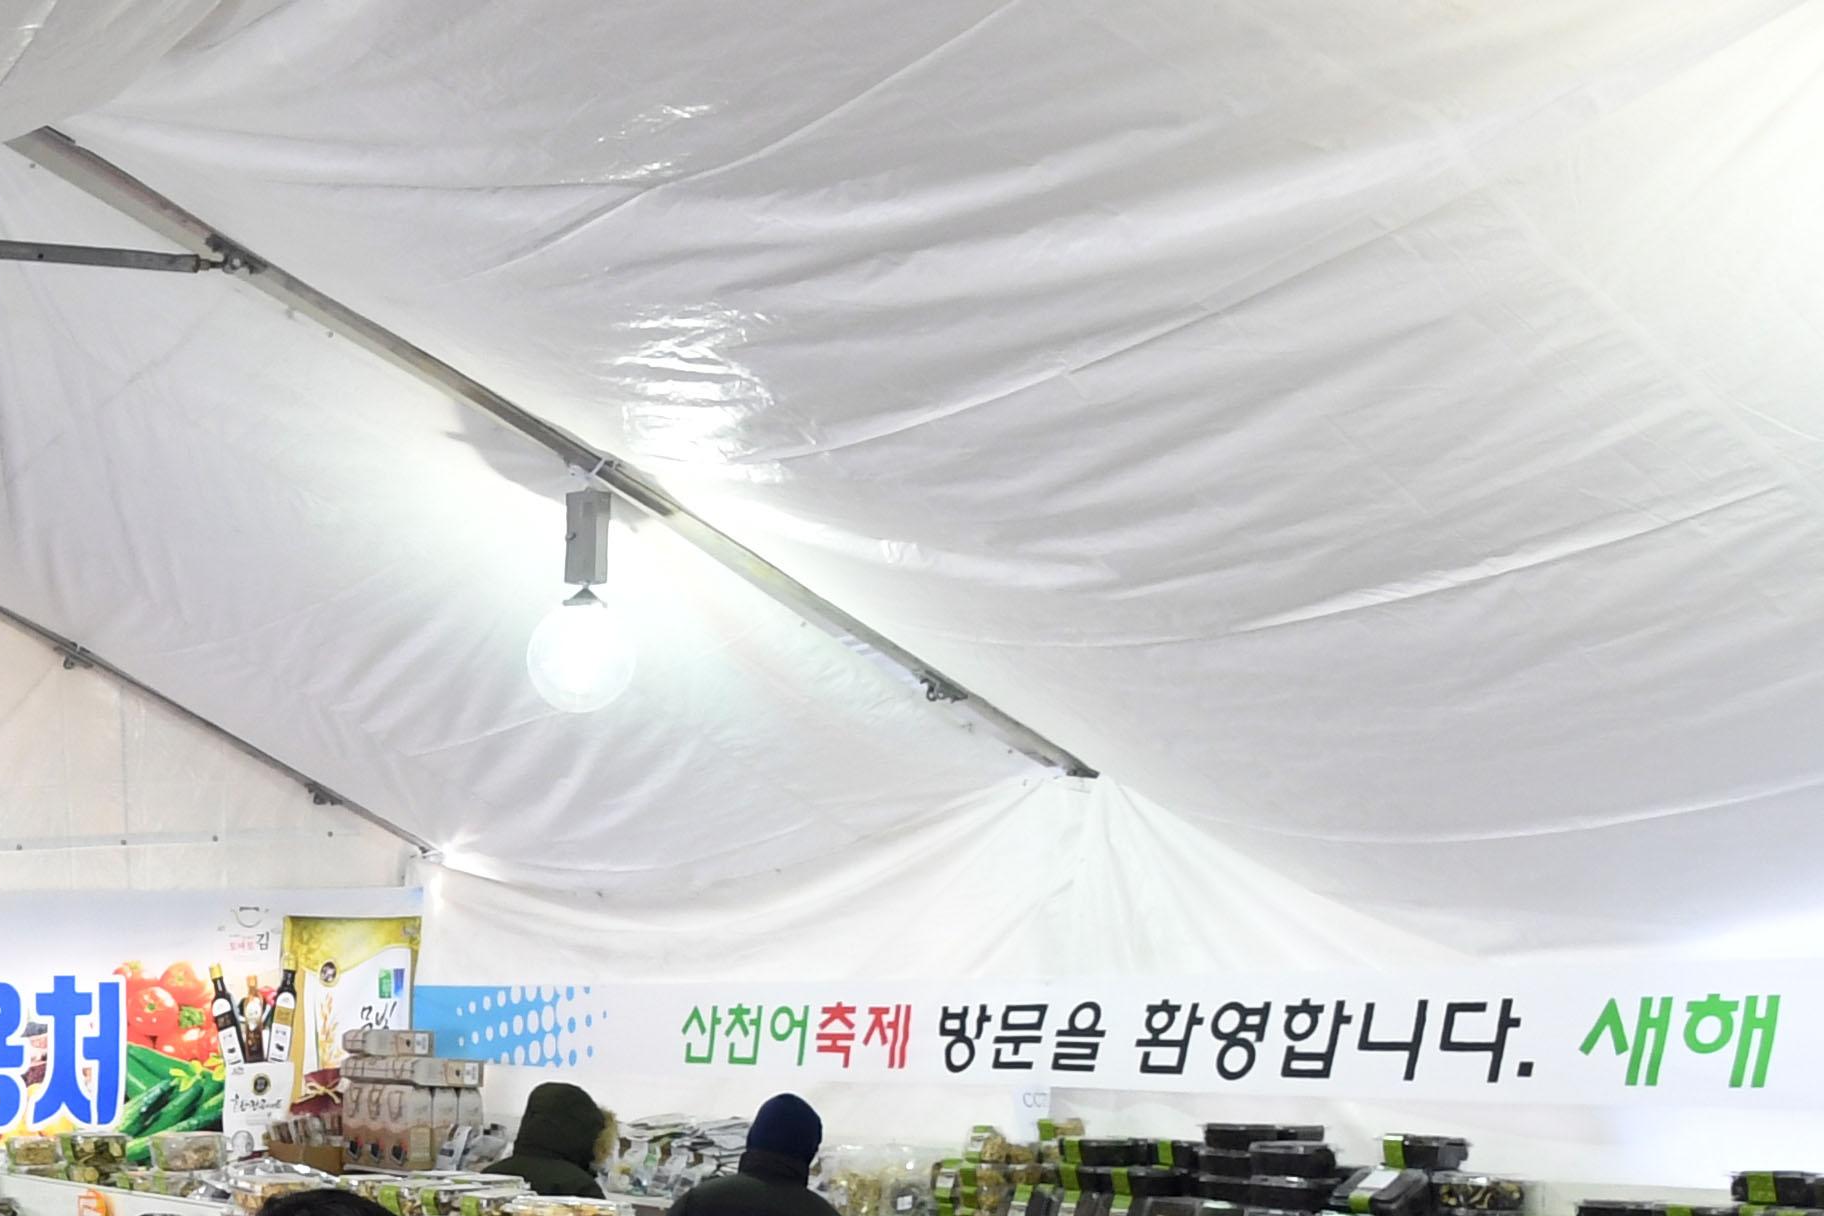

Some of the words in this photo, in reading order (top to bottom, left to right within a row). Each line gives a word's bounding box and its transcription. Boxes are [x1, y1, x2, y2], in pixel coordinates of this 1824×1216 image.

[680, 1002, 912, 1069] 산천어축제
[939, 1001, 1106, 1073] 방문을
[1135, 998, 1535, 1084] 환영합니다.
[1578, 993, 1781, 1088] 새해
